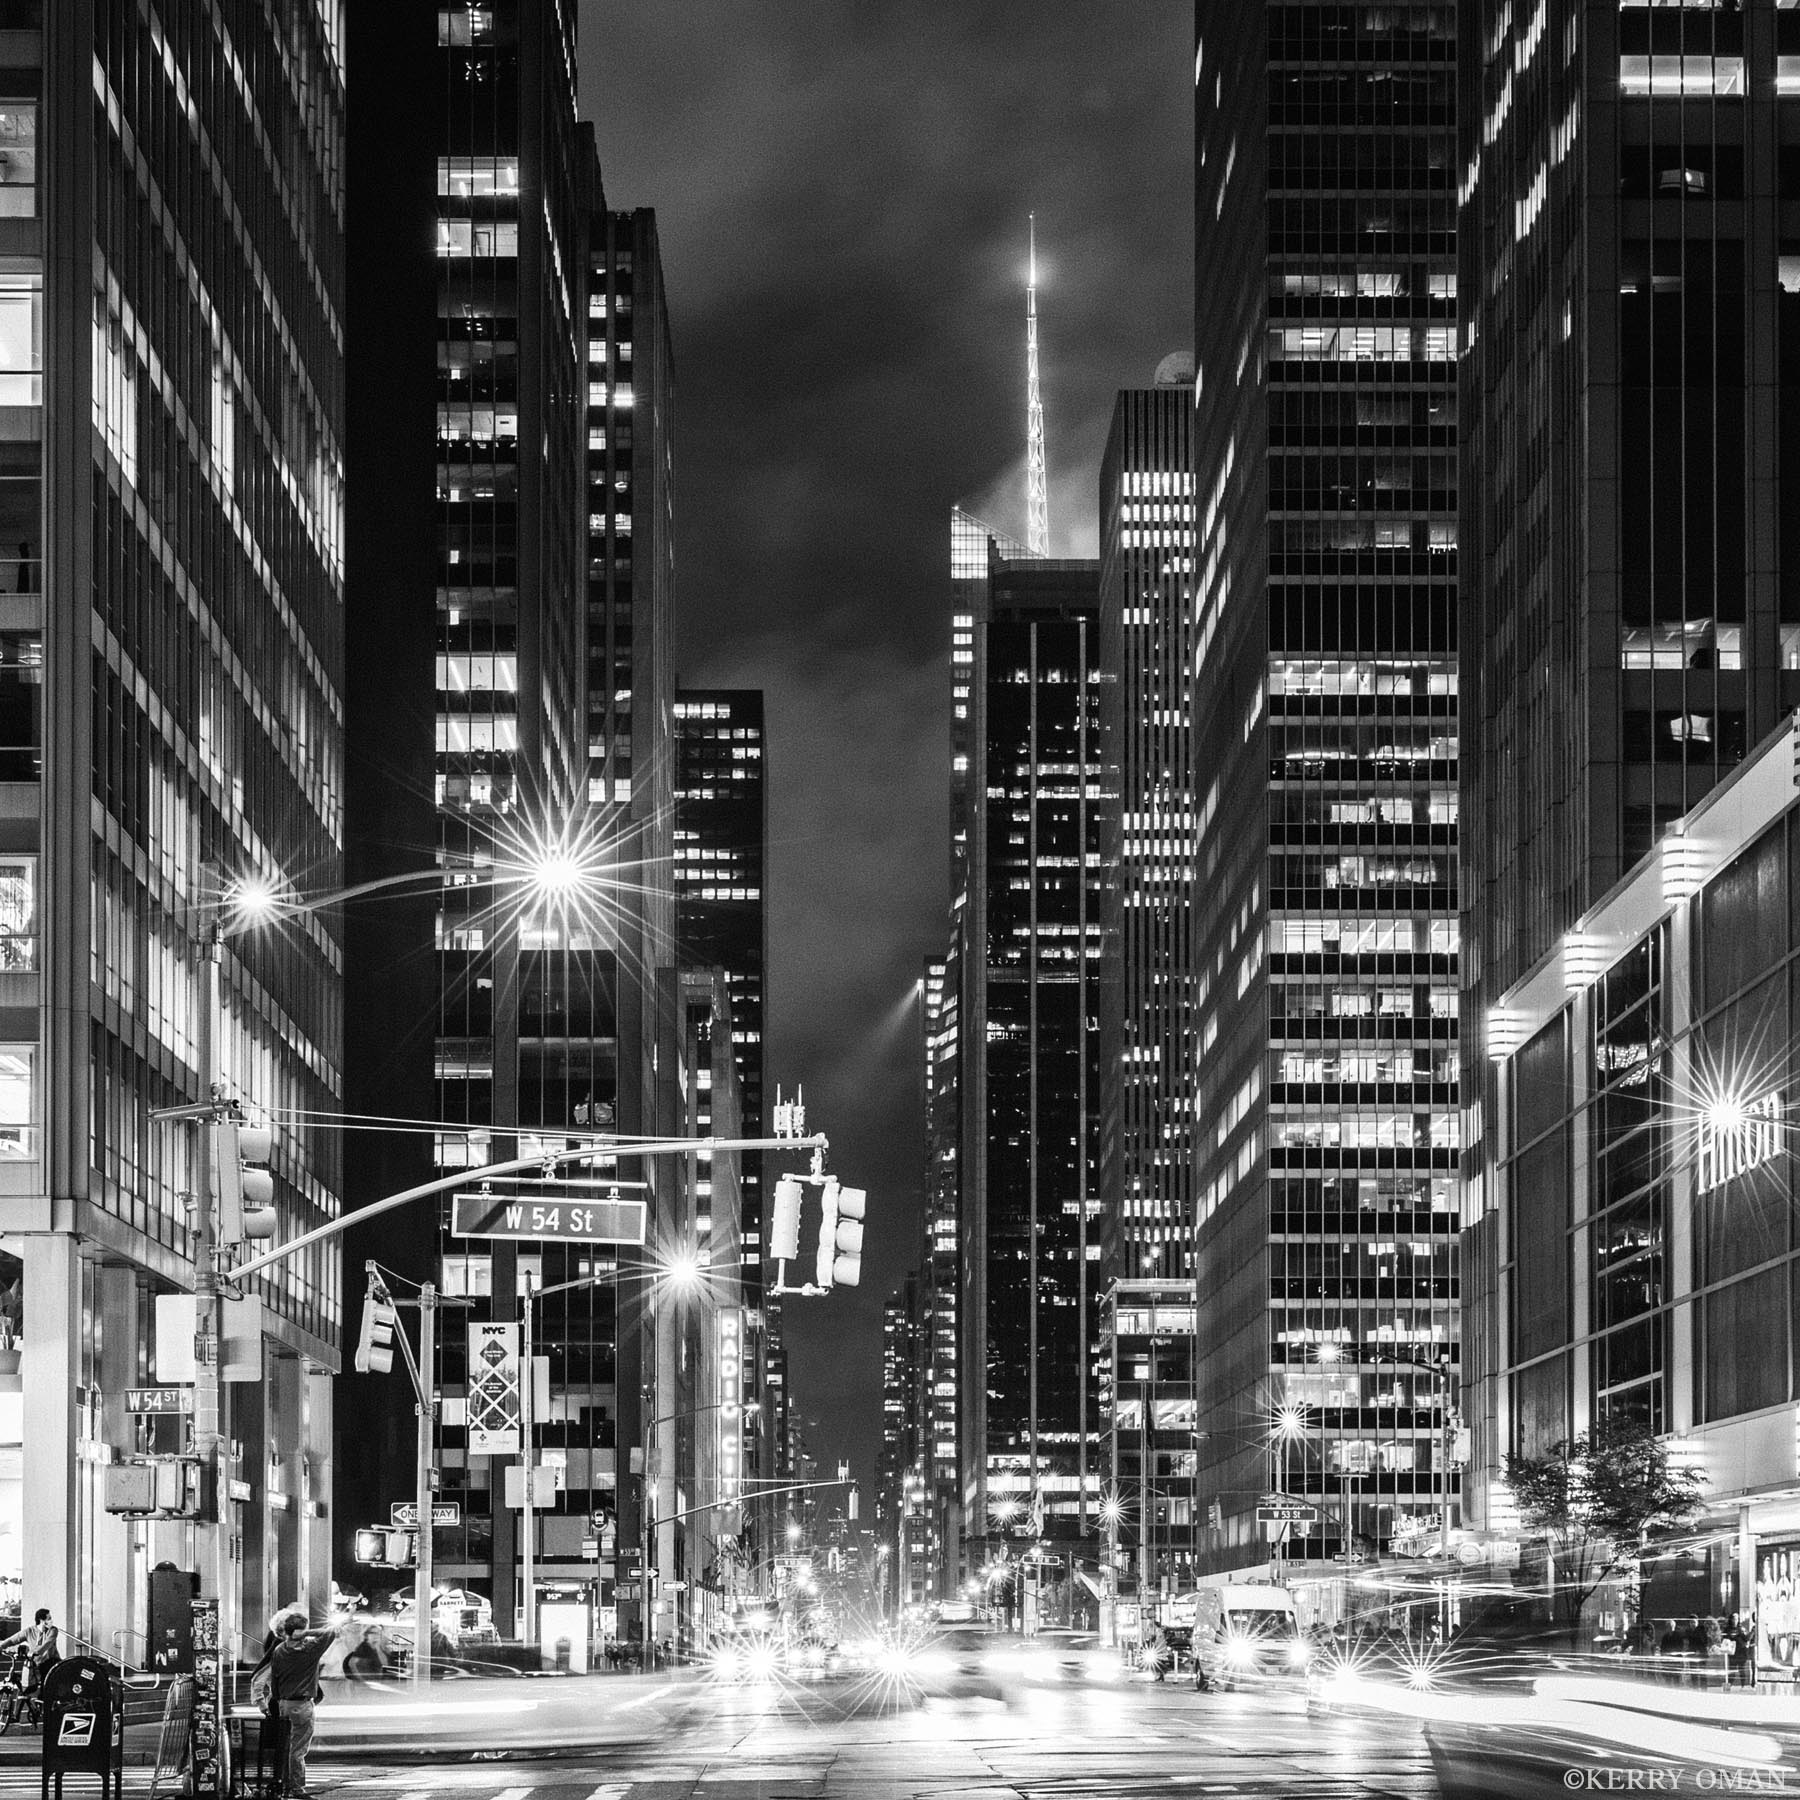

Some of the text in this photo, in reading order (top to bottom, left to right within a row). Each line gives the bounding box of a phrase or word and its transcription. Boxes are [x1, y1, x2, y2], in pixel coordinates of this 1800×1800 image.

[1698, 1091, 1781, 1195] Hilton
[506, 1206, 593, 1232] W 54 St
[482, 1326, 506, 1335] NYC
[721, 1316, 738, 1419] RADIO
[128, 1391, 177, 1411] W 54 ST
[400, 1509, 453, 1519] ONE WAY
[1281, 1511, 1291, 1519] 53
[1292, 1511, 1301, 1519] St
